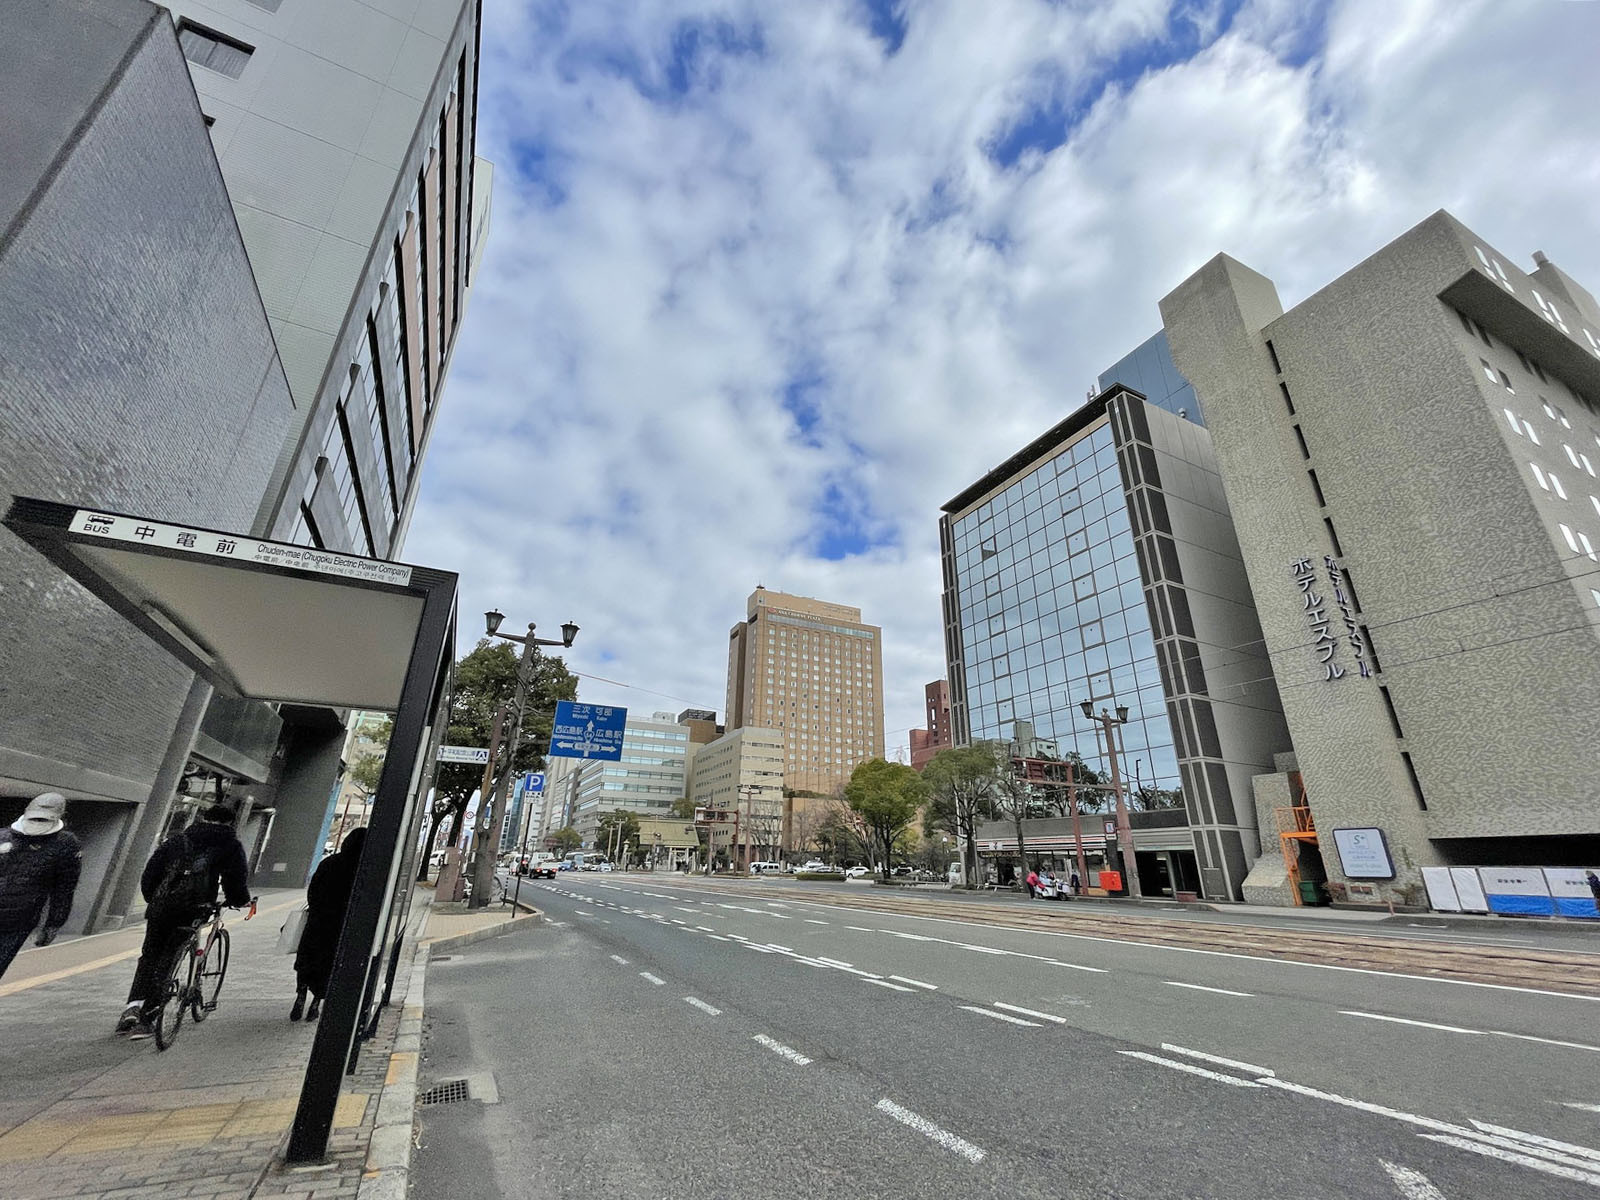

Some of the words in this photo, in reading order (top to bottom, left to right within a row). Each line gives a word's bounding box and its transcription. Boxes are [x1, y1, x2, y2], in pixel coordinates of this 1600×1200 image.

[84, 524, 109, 534] BUS
[135, 525, 237, 554] 中電前
[258, 543, 300, 559] Chuden-mae
[333, 557, 357, 569] Electric
[358, 561, 378, 572] Power
[1292, 558, 1346, 681] ホテルエスプル
[572, 704, 590, 714] 三次
[595, 729, 622, 739] 広島駅
[529, 776, 541, 790] P
